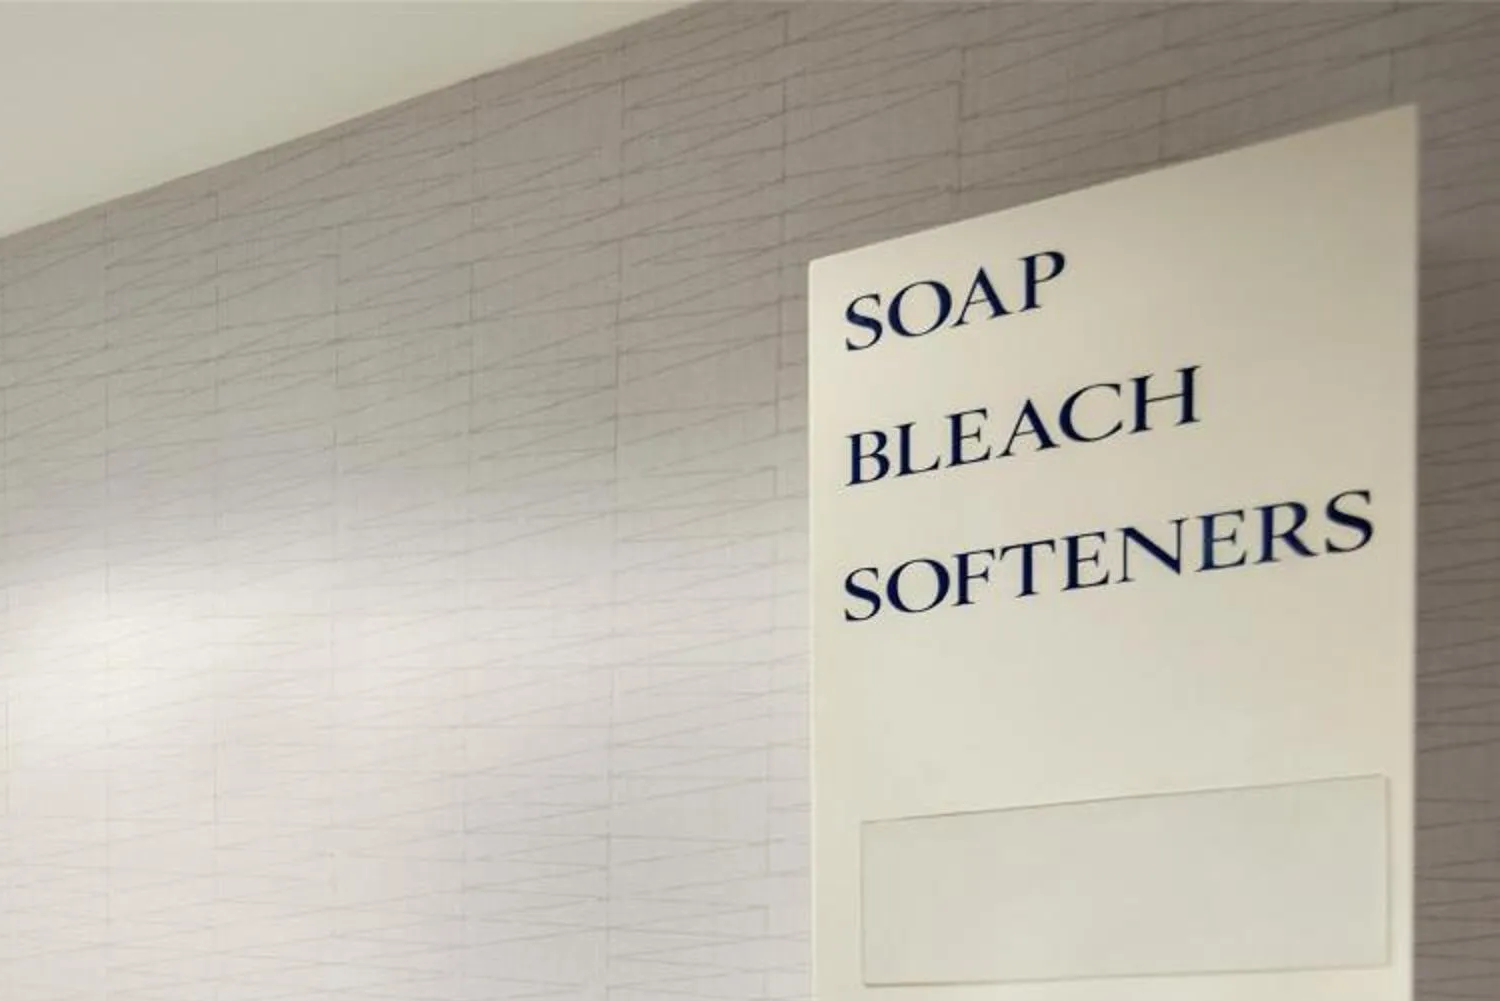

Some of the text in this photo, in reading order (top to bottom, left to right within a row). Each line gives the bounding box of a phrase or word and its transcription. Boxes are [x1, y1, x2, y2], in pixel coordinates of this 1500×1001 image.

[845, 251, 1065, 351] SOAP
[846, 365, 1200, 486] BLEACH
[844, 490, 1374, 622] SOFTENERS
